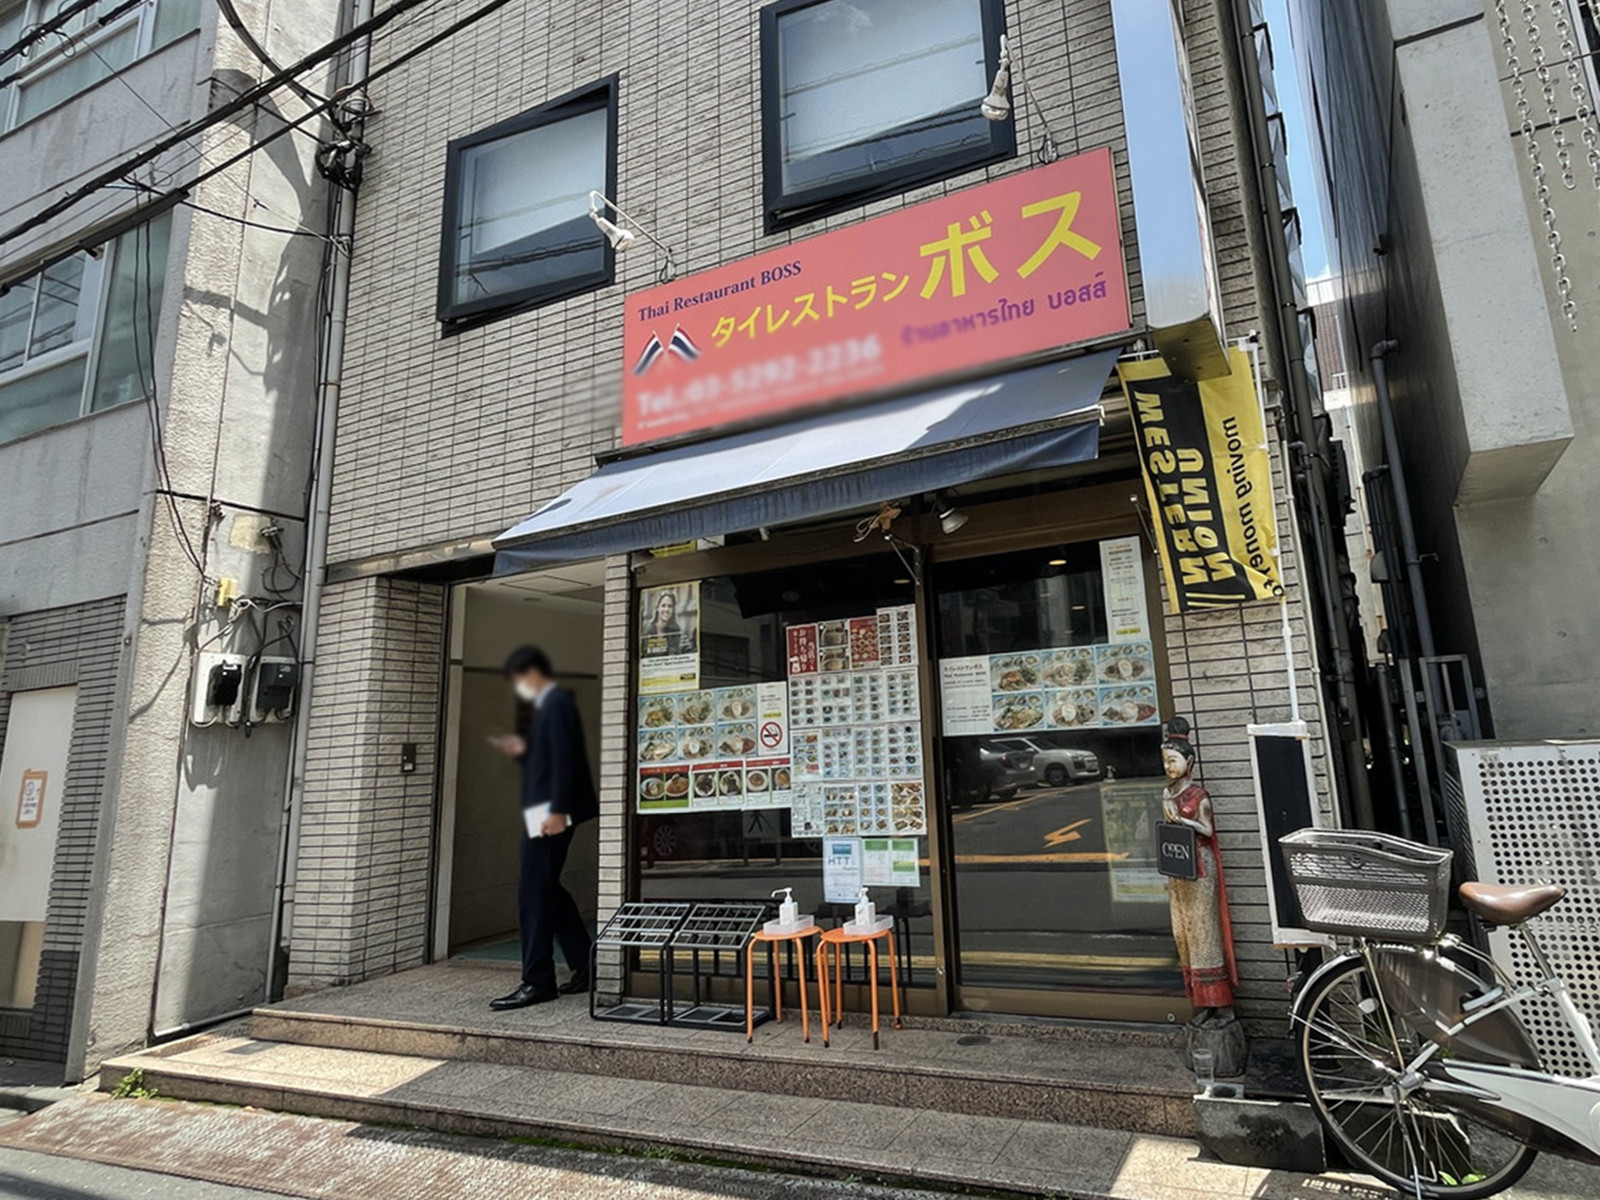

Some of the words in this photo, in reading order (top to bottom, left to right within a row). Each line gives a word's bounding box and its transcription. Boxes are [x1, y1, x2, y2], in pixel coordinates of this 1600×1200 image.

[638, 300, 670, 321] Thai
[673, 277, 756, 311] Restaurant
[760, 260, 802, 286] BOSS
[711, 271, 910, 348] タイレストラン
[919, 190, 1102, 300] ボス
[1162, 841, 1190, 859] OPEN
